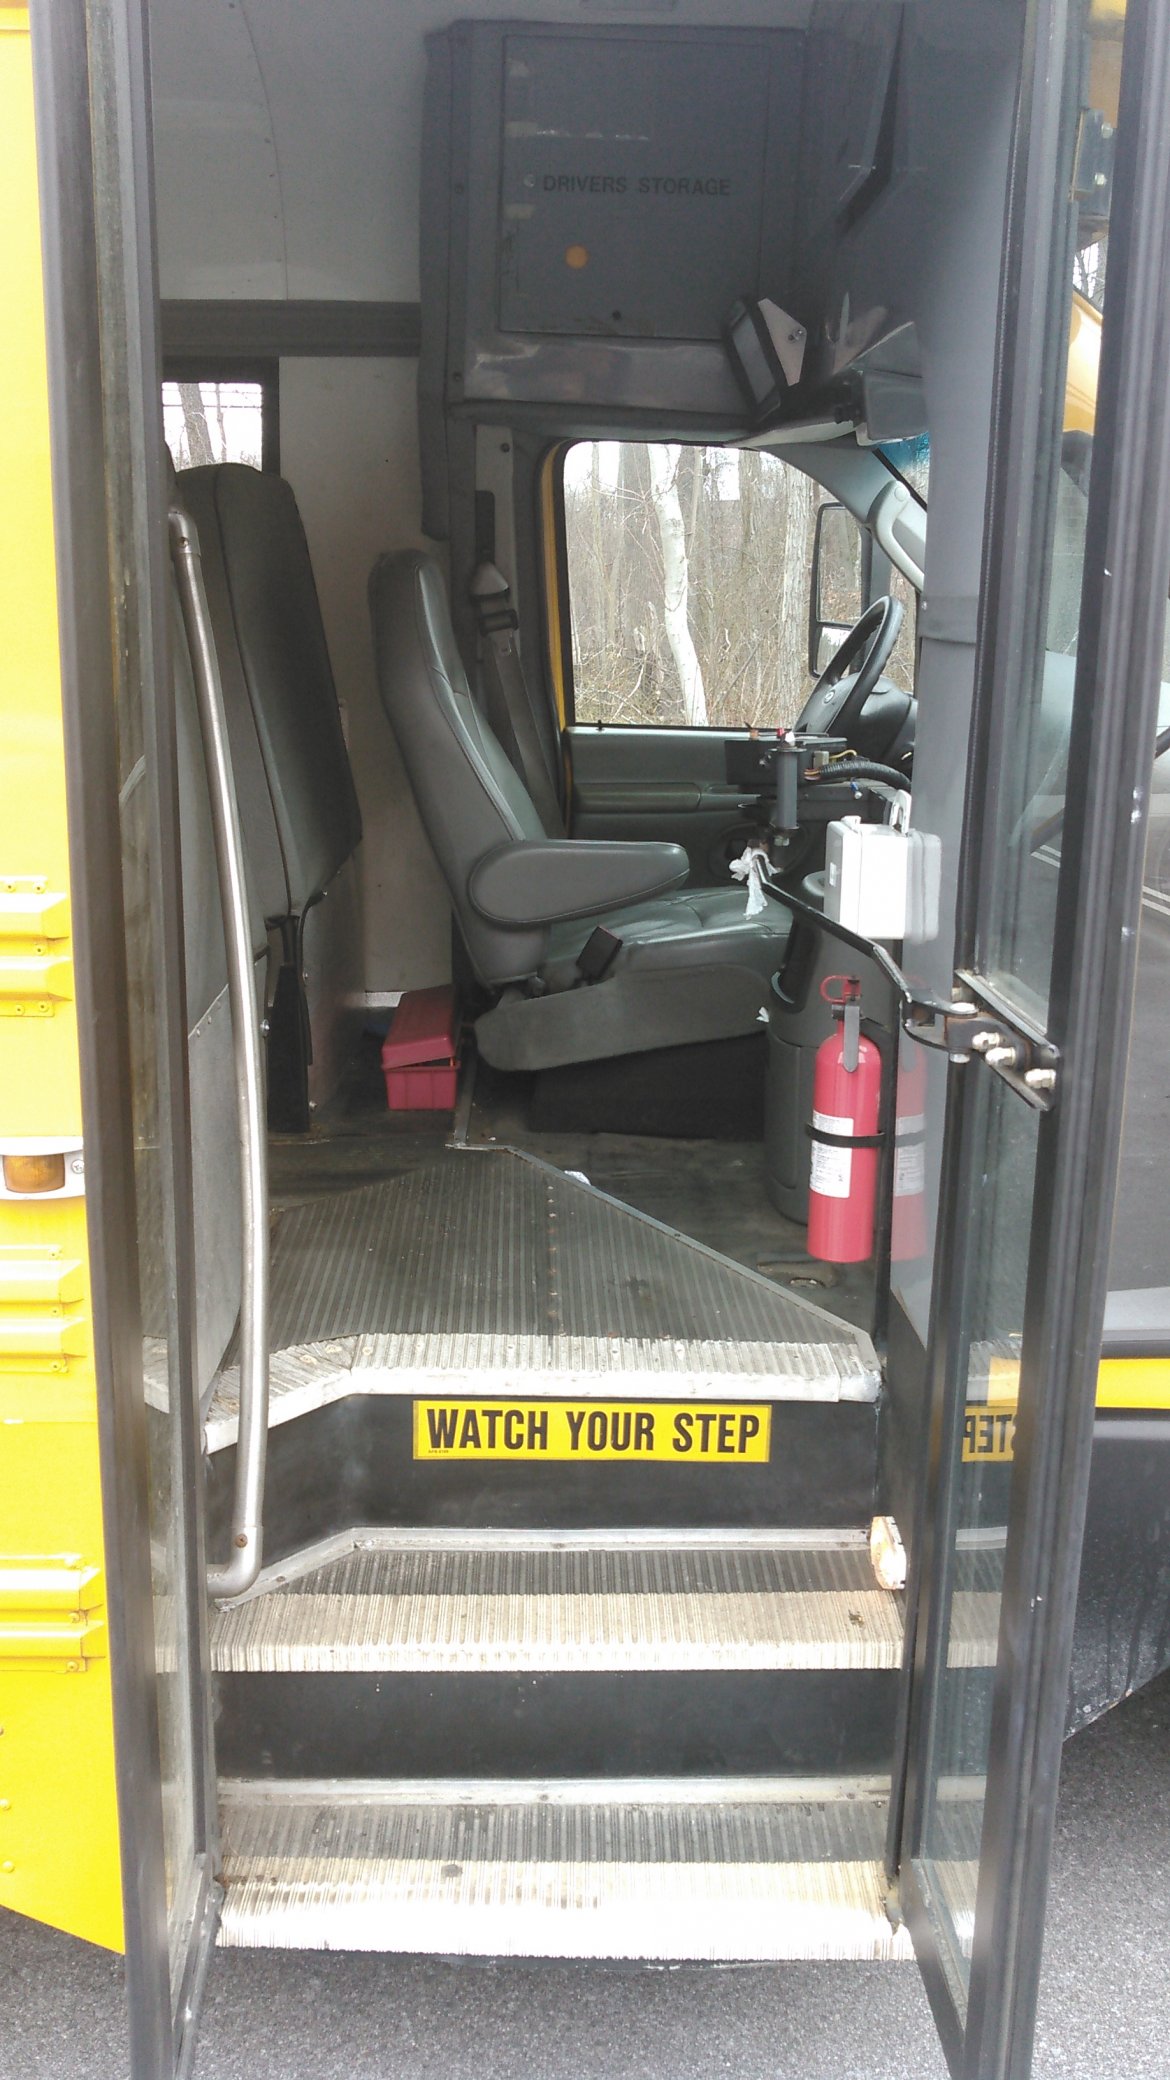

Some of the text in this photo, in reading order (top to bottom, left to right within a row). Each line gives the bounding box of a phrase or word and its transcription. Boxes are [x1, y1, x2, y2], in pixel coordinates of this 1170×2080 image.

[543, 175, 731, 196] DRIVERS STORAGE
[426, 1408, 760, 1454] WATCH YOUR STEP
